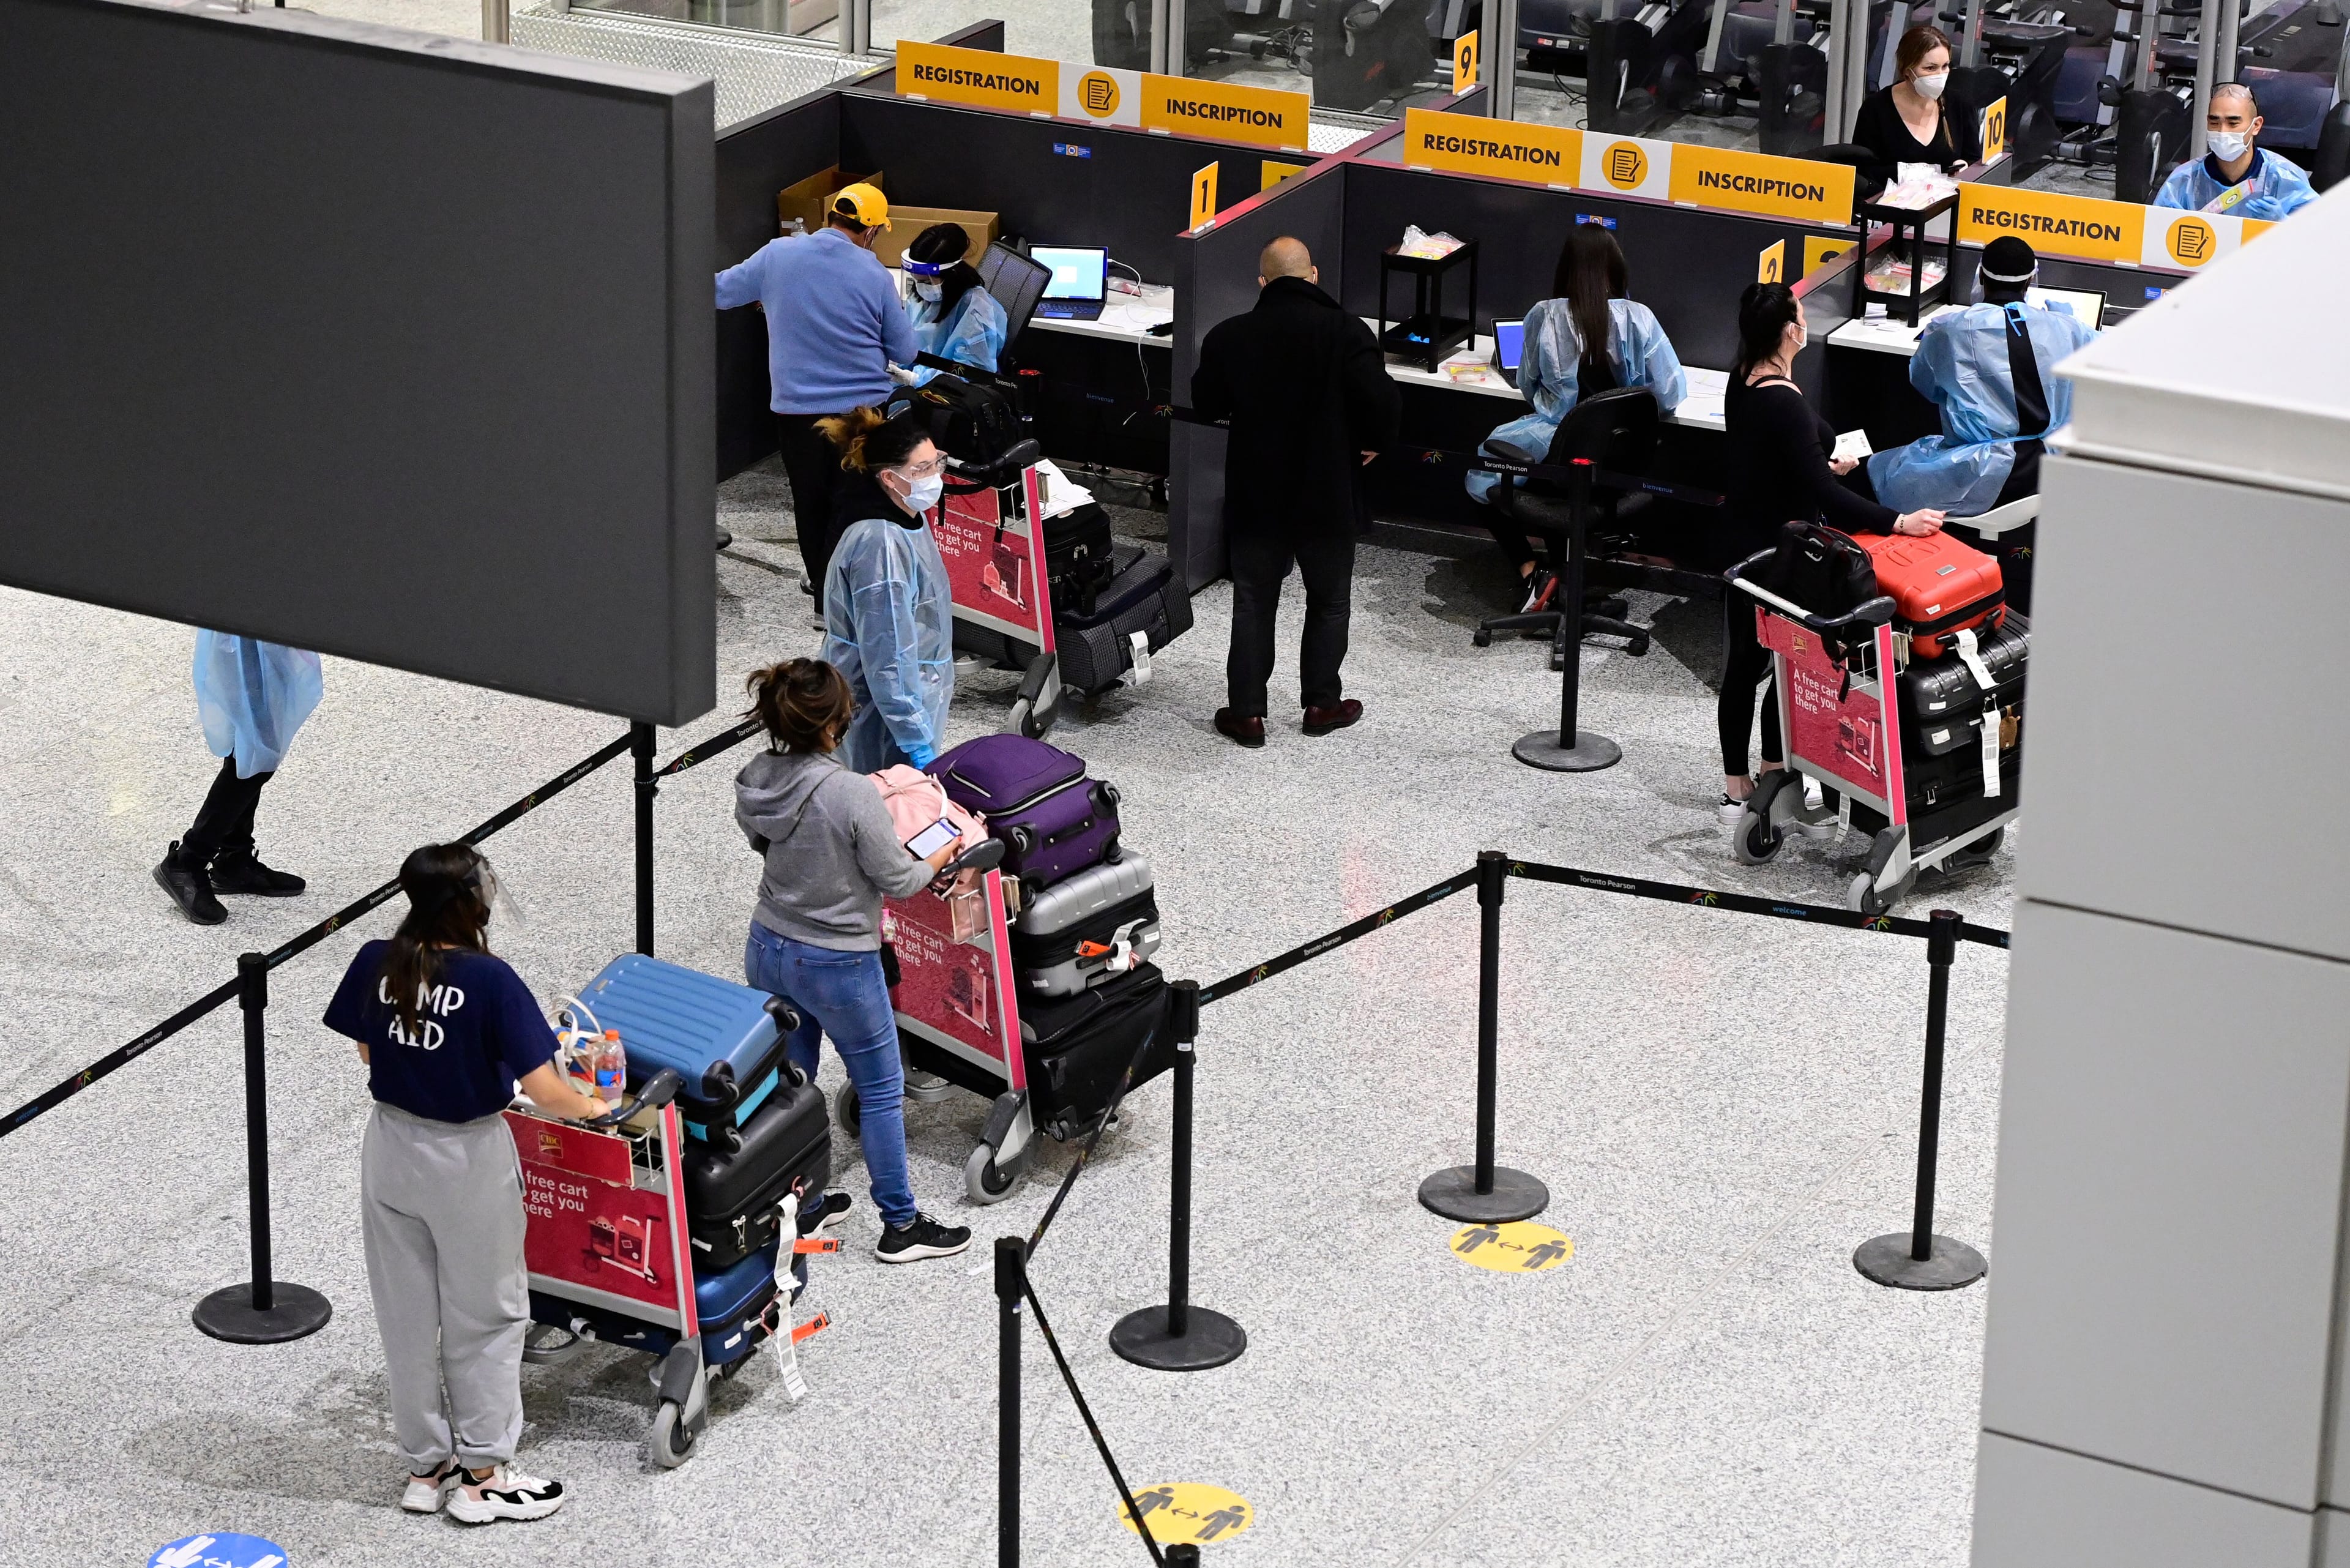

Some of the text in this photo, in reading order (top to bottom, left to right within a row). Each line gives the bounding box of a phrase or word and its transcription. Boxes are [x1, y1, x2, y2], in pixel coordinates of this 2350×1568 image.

[1461, 45, 1471, 79] 9
[914, 64, 1039, 95] REGISTRATION
[1166, 99, 1282, 129] INSCRIPTION
[1988, 111, 2002, 149] 10
[1423, 133, 1560, 166] REGISTRATION
[1202, 179, 1208, 213] 1
[1698, 170, 1824, 202] INSCRIPTION
[1972, 207, 2121, 242] REGISTRATION
[1767, 258, 1777, 283] 2
[1086, 392, 1114, 403] bienvenue
[1484, 461, 1528, 472] Toronto Pearson
[1643, 482, 1674, 494] bienvenue
[934, 528, 980, 552] to get you
[963, 528, 982, 542] cart
[936, 540, 960, 556] there
[1794, 668, 1838, 701] A free cart
[1794, 682, 1837, 711] to get you
[1795, 693, 1818, 714] there
[736, 723, 759, 737] Toronto
[1579, 875, 1636, 890] Toronto Pearson
[1772, 906, 1807, 916] welcome
[902, 921, 922, 941] free
[923, 935, 944, 952] cart
[1304, 936, 1341, 956] Toronto Pearson
[894, 944, 920, 966] there
[906, 939, 922, 955] get
[923, 947, 942, 964] you
[379, 976, 465, 1017] CMP
[126, 1031, 162, 1056] Toronto Pearson
[388, 1014, 444, 1051] AID
[540, 1135, 560, 1146] CIBC
[526, 1170, 588, 1199] free cart
[531, 1190, 554, 1204] get
[558, 1197, 584, 1212] you
